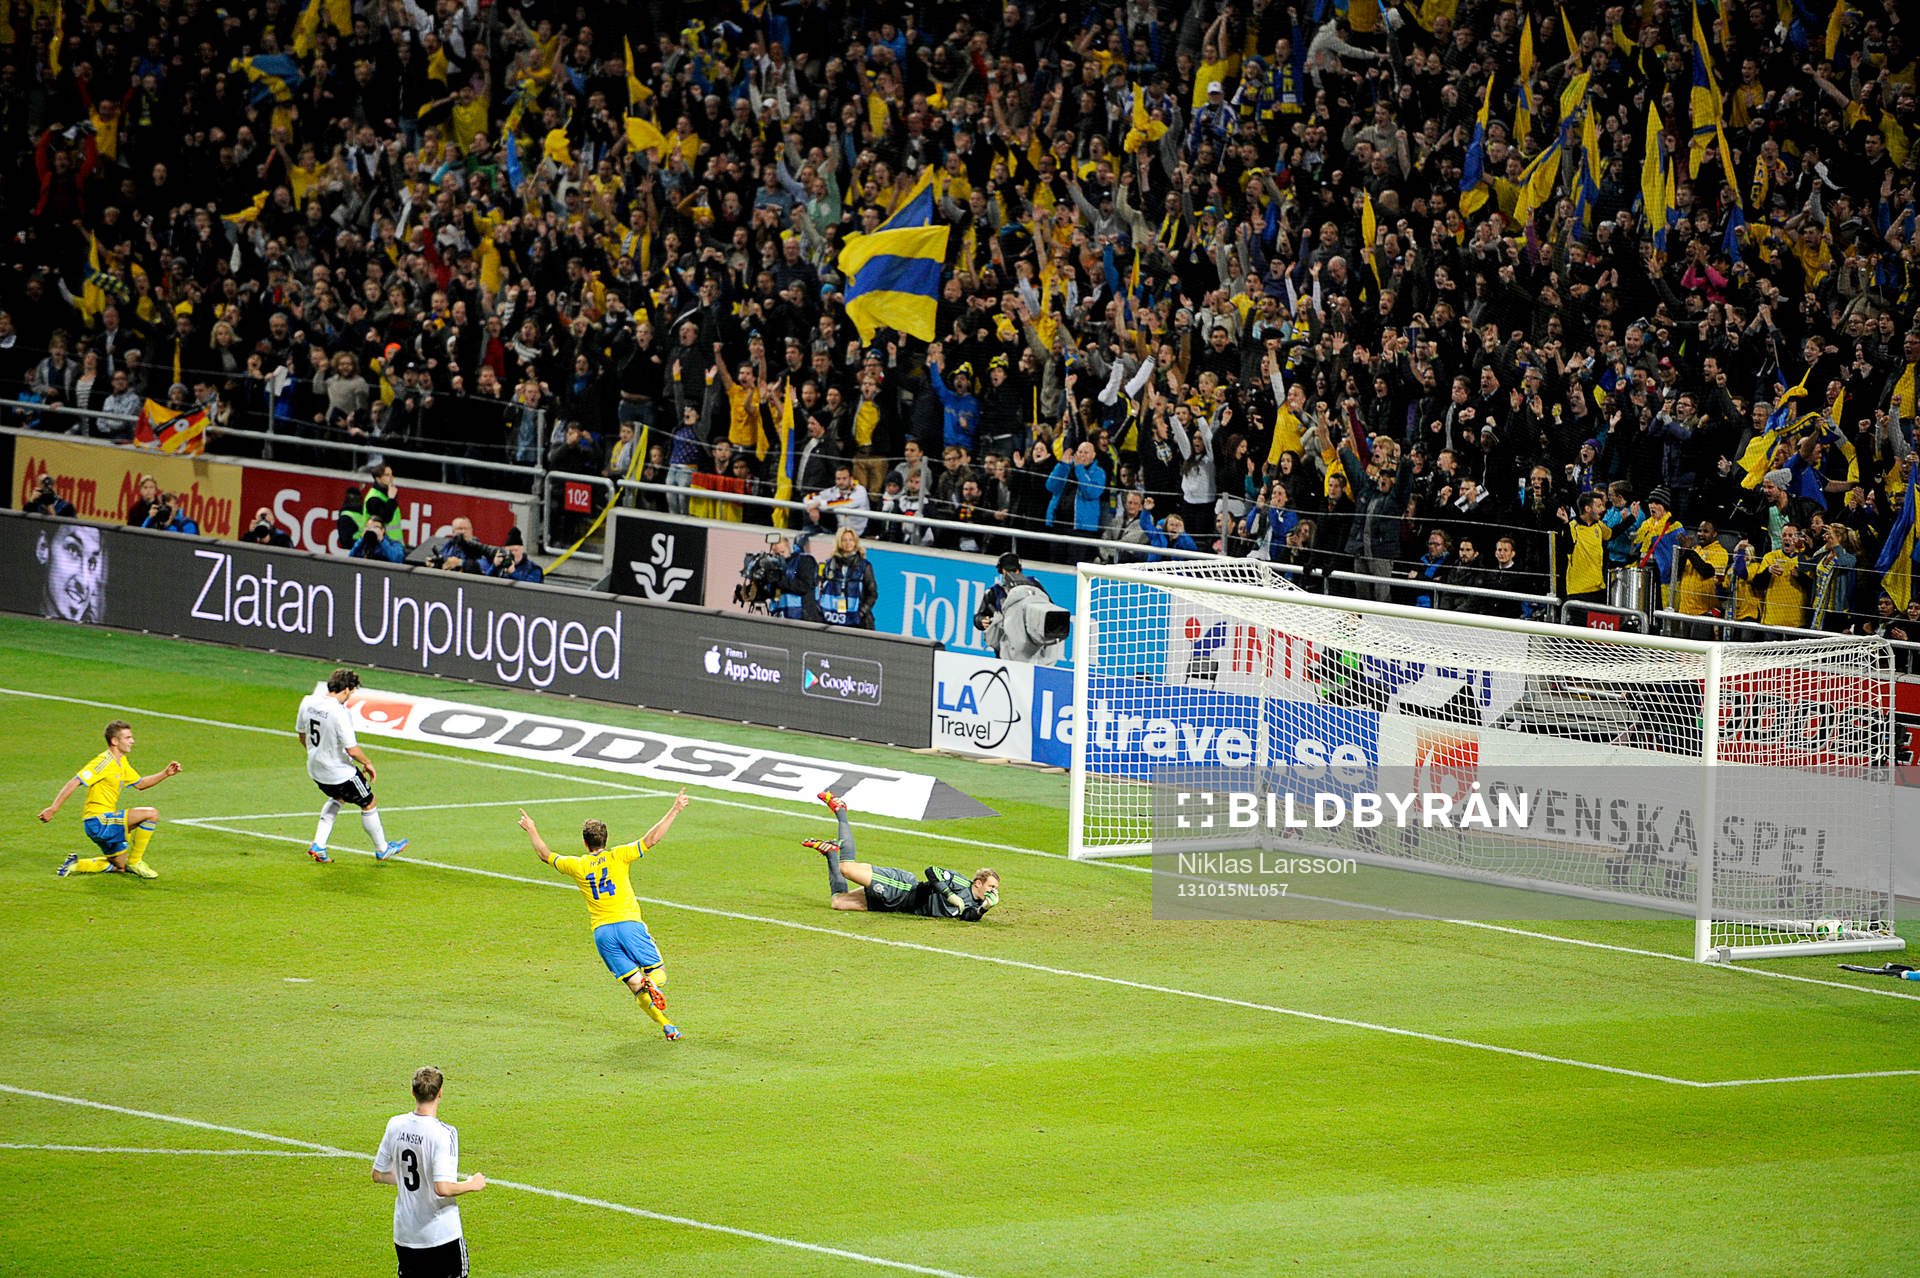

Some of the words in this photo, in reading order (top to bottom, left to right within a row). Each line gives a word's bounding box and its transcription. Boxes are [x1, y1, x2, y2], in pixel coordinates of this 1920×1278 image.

[567, 488, 590, 507] 102
[651, 533, 675, 568] SJ
[191, 549, 335, 638] Zlatan
[354, 572, 622, 688] Unplugged
[724, 659, 749, 682] App
[749, 662, 781, 684] Store
[819, 672, 857, 697] Google
[857, 680, 879, 698] play
[937, 681, 979, 715] LA
[310, 718, 321, 748] 5
[937, 715, 991, 741] Travel
[419, 708, 901, 798] ODDSET
[1488, 780, 1699, 857] SVENSKA
[1721, 815, 1838, 878] SPEL
[585, 867, 616, 900] 14
[401, 1148, 420, 1192] 3
